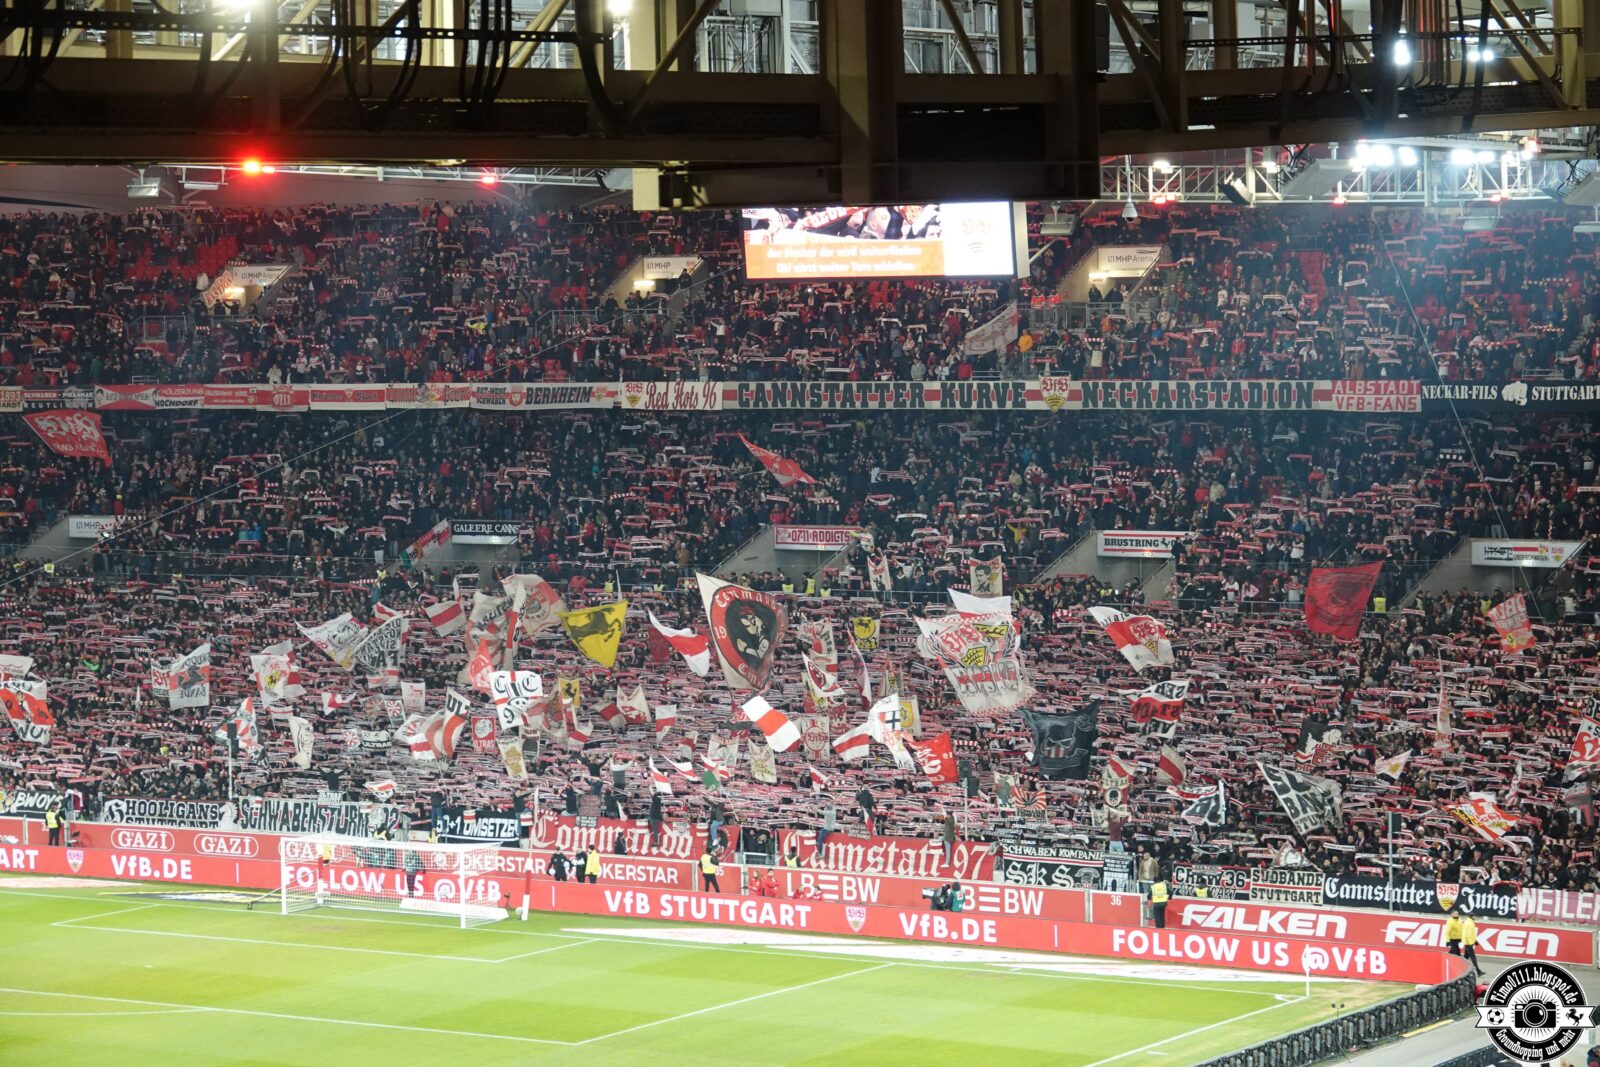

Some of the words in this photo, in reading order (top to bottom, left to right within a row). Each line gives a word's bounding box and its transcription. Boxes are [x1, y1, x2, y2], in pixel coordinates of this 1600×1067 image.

[525, 386, 593, 404] BERKHEIM
[644, 381, 670, 409] Red
[672, 380, 698, 409] Hots
[702, 382, 718, 409] 96
[737, 382, 925, 410] CANNSTATTER
[940, 382, 1027, 409] KURVE
[1082, 381, 1315, 410] NECKARSTADION
[1334, 380, 1420, 395] ALBSTADT
[1422, 385, 1498, 401] NECKAR-FILS
[1532, 386, 1600, 401] STUTTGART
[154, 400, 198, 408] HOCHDORF
[1336, 396, 1418, 412] VFB-FANS
[454, 524, 494, 533] GALEERE
[1104, 538, 1159, 548] BRUSTRING
[714, 626, 727, 639] 19
[15, 792, 64, 810] BWOYS
[125, 800, 218, 820] HOOLIGANS
[240, 798, 369, 838] SCHWABENSTURM
[954, 842, 988, 880] 97
[1002, 844, 1055, 859] SCHWABEN
[111, 855, 192, 880] VfB.DE
[600, 863, 678, 884] KERSTAR
[395, 874, 424, 897] US
[1225, 870, 1246, 888] 36
[1110, 895, 1121, 906] 36
[1251, 888, 1321, 904] STUTTGART
[1325, 877, 1434, 906] Cannstatter
[1459, 886, 1518, 916] Jungs
[604, 890, 650, 914] VfB
[660, 894, 811, 928] STUTTGART
[900, 912, 998, 942] VfB.DE
[1180, 903, 1348, 940] FALKEN
[1112, 929, 1240, 962] FOLLOW
[1252, 941, 1290, 967] US
[1302, 946, 1387, 975] @VfB
